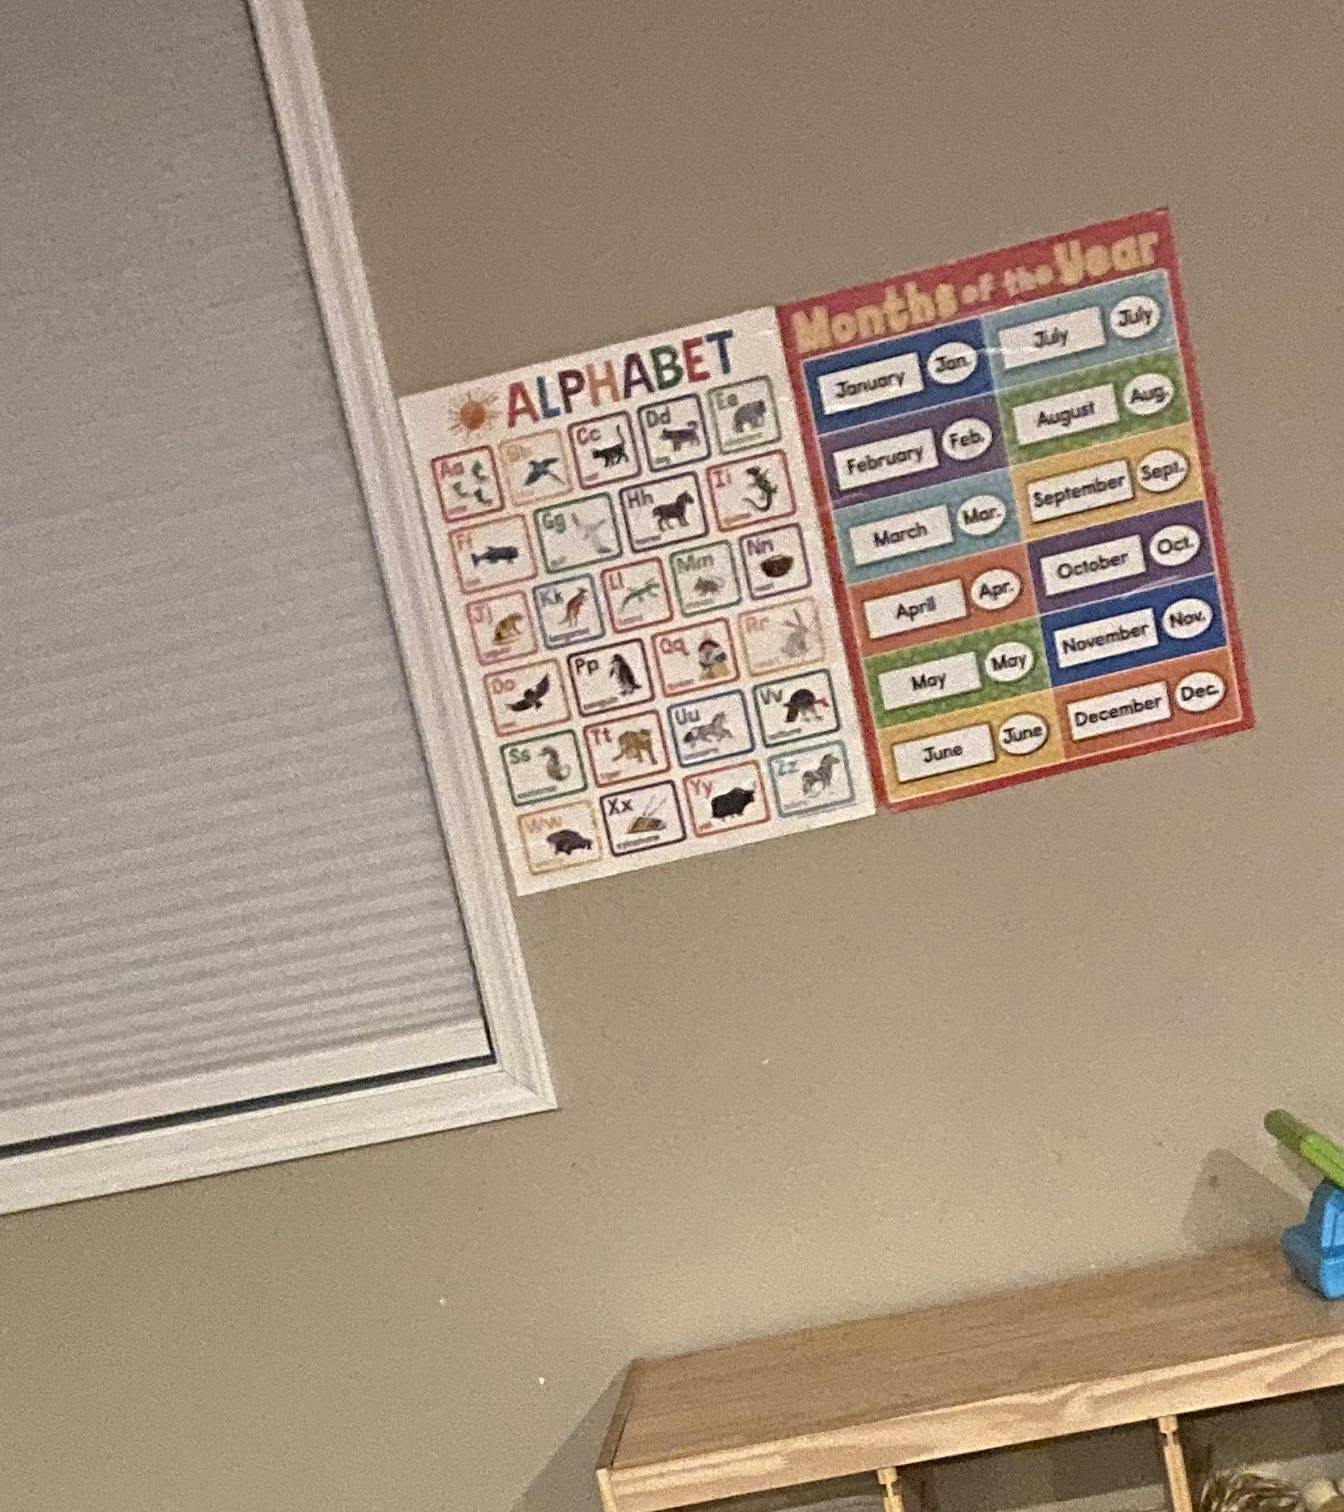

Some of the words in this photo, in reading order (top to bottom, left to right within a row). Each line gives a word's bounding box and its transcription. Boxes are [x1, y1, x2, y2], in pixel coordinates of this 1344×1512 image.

[792, 281, 958, 354] Months
[961, 277, 995, 306] of
[1004, 263, 1055, 298] the
[1056, 230, 1159, 286] Year
[1117, 303, 1154, 329] July
[1033, 324, 1070, 349] July
[507, 328, 734, 428] ALPHABET
[834, 368, 907, 399] January
[645, 407, 671, 428] Dd
[1036, 402, 1095, 428] August
[575, 427, 601, 445] Cc
[846, 444, 925, 475] February
[626, 488, 654, 510] Hh
[1033, 474, 1126, 509] September
[542, 512, 567, 534] Gg
[873, 522, 927, 547] March
[747, 539, 774, 556] Nn
[676, 555, 714, 573] Mm
[1056, 552, 1129, 579] October
[895, 597, 937, 621] April
[1061, 622, 1149, 654] November
[575, 658, 599, 676] Pp
[990, 653, 1027, 673] May
[910, 671, 947, 694] May
[674, 708, 700, 726] Uu
[1074, 695, 1162, 727] December
[590, 728, 613, 746] Tt
[1003, 724, 1043, 743] June
[508, 749, 532, 764] Ss
[923, 743, 963, 764] June
[690, 779, 713, 799] Yy
[608, 798, 634, 816] Xx
